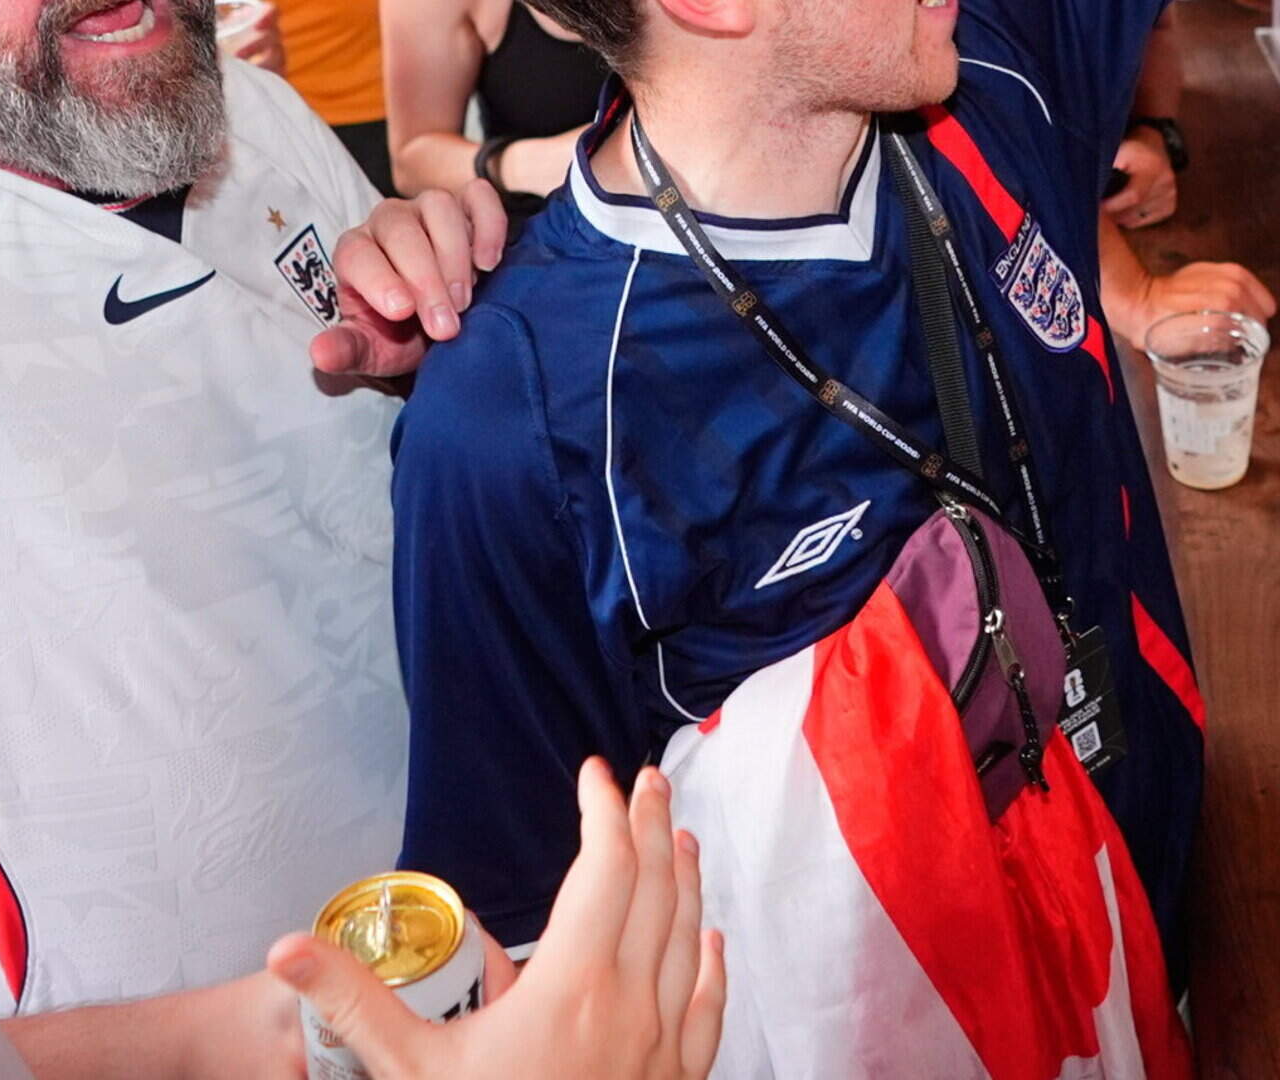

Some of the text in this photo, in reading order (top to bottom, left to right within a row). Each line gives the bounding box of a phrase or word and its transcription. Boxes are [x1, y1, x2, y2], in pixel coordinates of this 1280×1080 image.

[673, 212, 688, 230] FIFA
[684, 227, 705, 255] WORLD
[701, 252, 716, 268] CUP
[995, 211, 1031, 280] ENGLAND
[766, 327, 787, 352] WORLD
[783, 348, 797, 362] CUP
[841, 398, 858, 415] FIFA
[857, 409, 883, 432] WORLD
[880, 427, 897, 441] CUP
